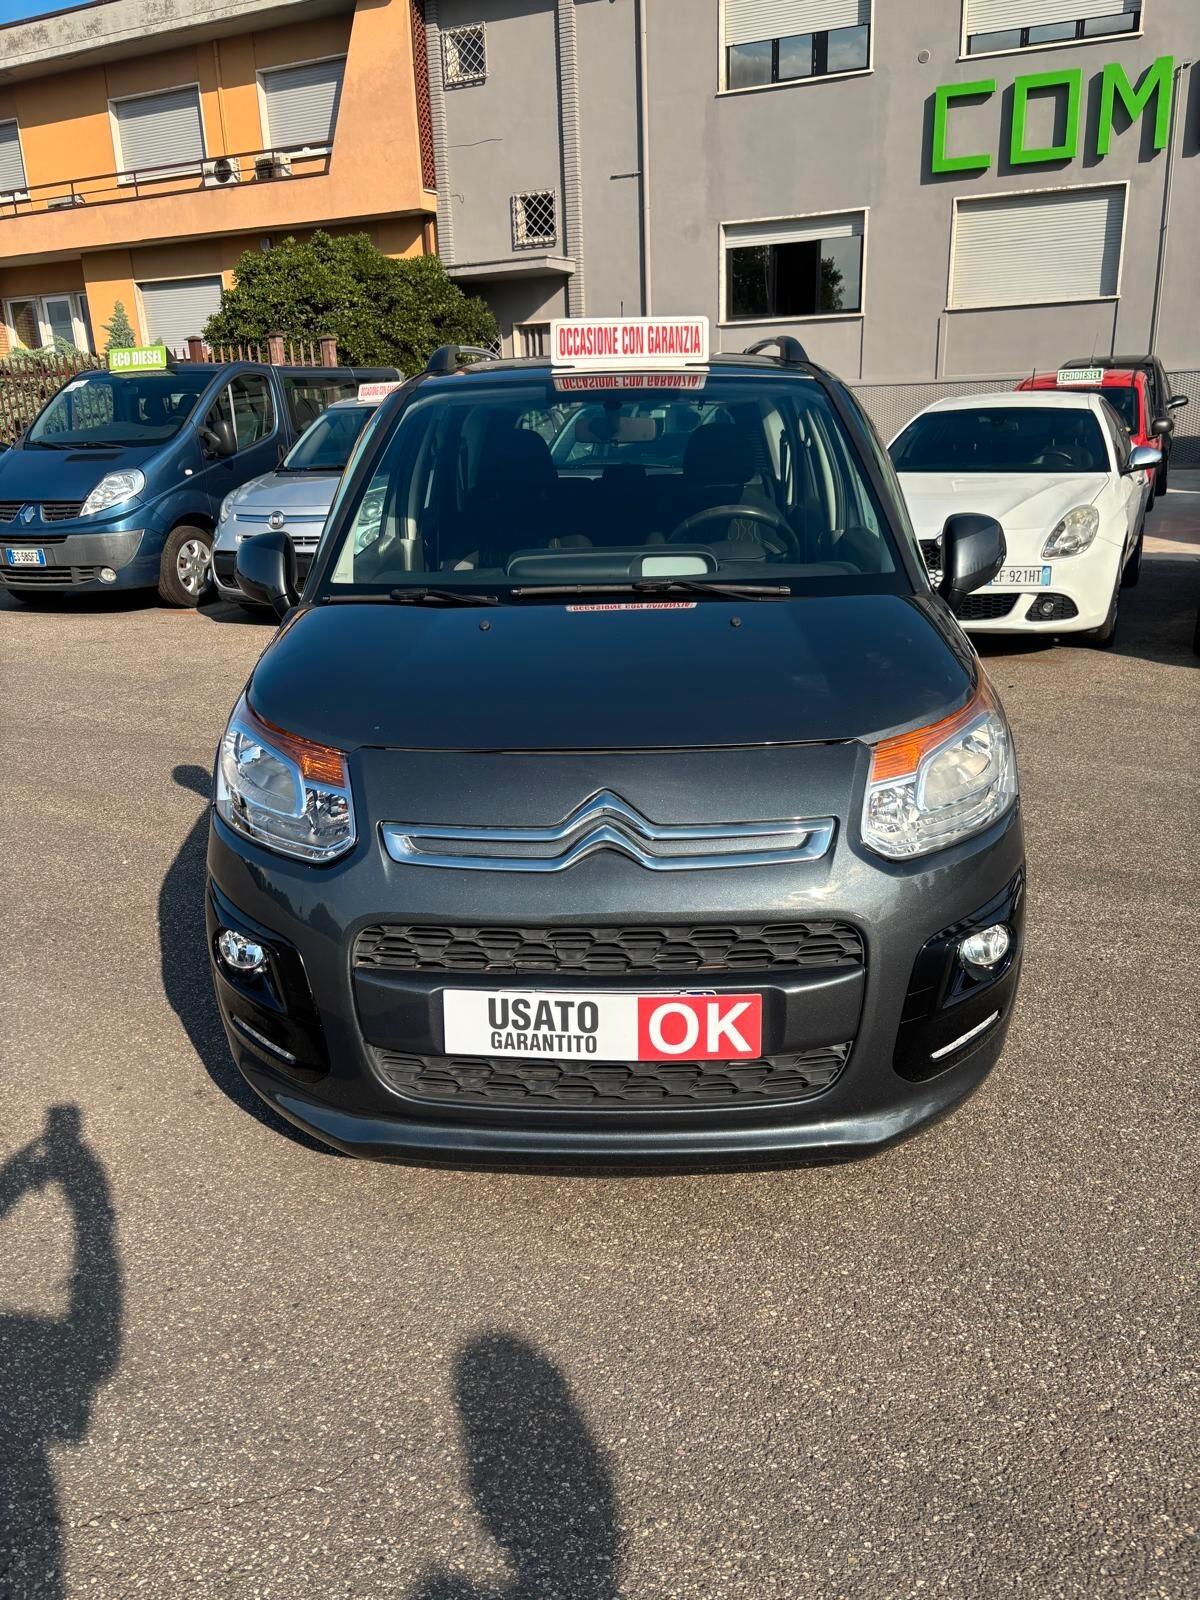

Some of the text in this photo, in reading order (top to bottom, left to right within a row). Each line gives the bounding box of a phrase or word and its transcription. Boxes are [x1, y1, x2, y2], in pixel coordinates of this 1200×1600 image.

[931, 55, 1175, 173] COM
[559, 324, 701, 356] OCCASIONE CON GARANZIA
[112, 349, 162, 367] ECO DIESEL
[1060, 370, 1102, 381] ECODIESEL
[487, 997, 599, 1034] USATO
[648, 1001, 753, 1055] OK
[490, 1031, 598, 1054] GARANTITO
